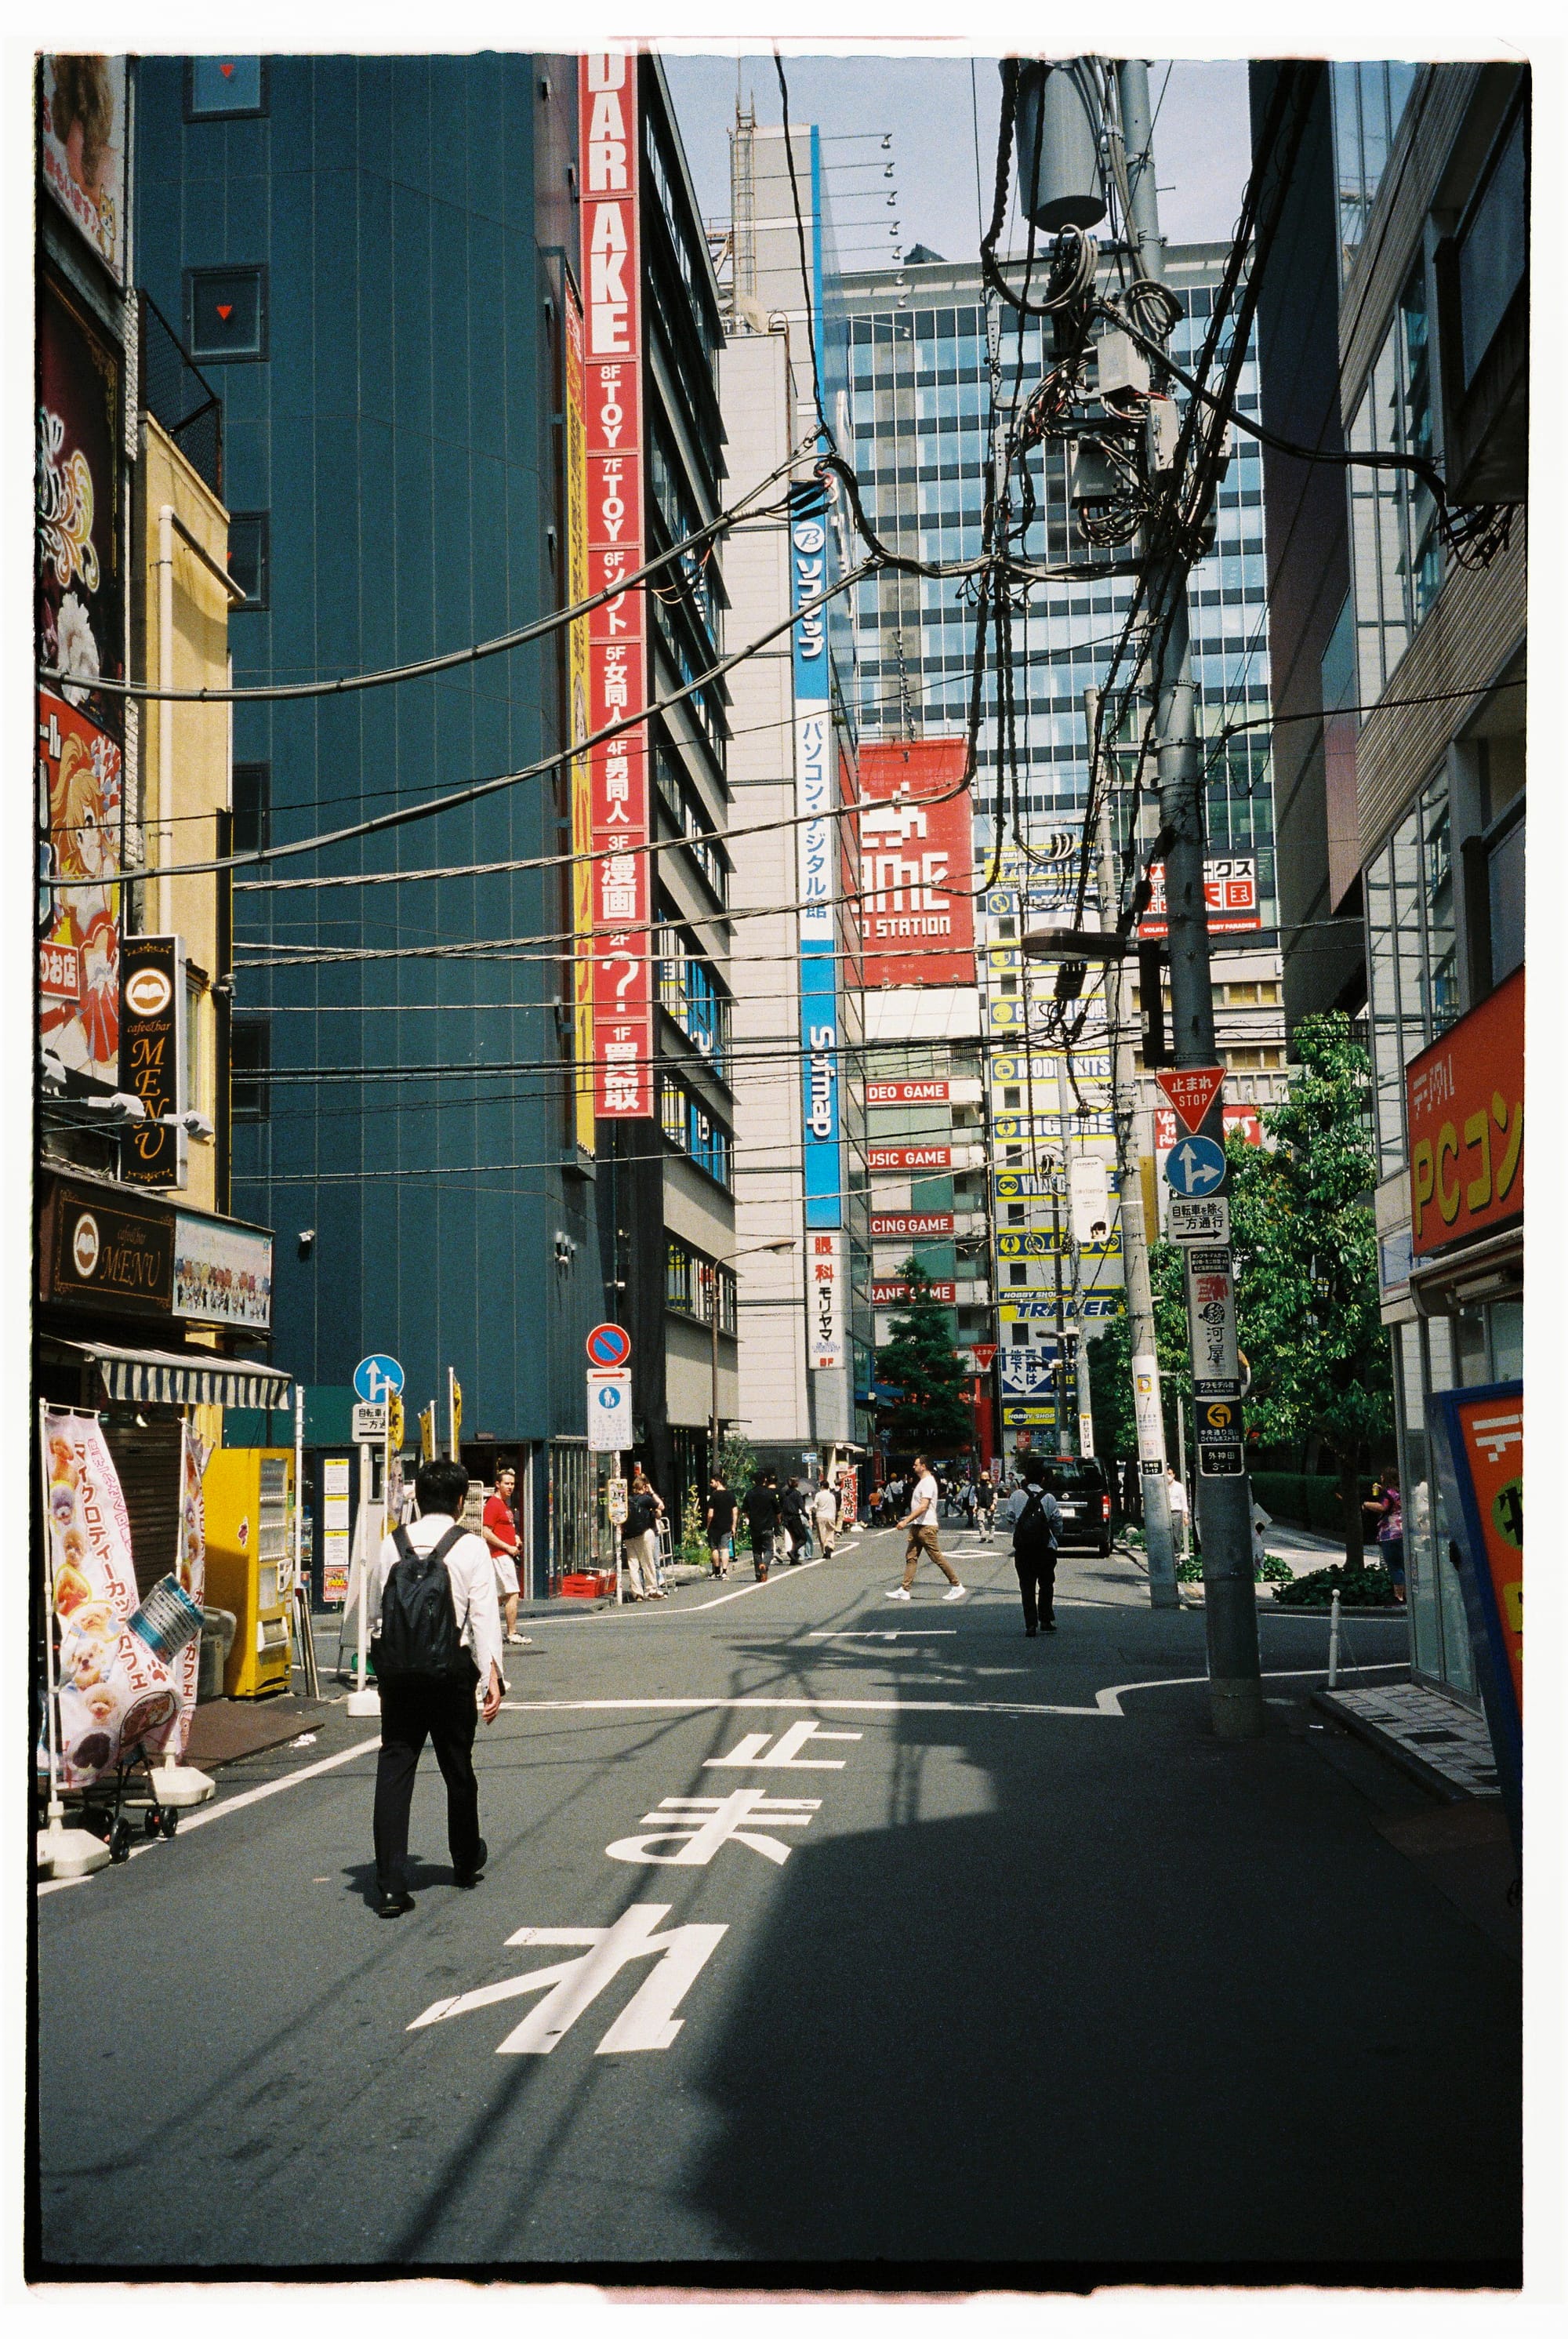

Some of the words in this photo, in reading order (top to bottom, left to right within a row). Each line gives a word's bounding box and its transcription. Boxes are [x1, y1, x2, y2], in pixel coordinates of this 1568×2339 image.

[601, 365, 620, 380] 8F
[601, 381, 623, 448] TOY
[603, 458, 622, 472] 7F
[603, 474, 624, 542] TOY
[604, 552, 624, 566] 6F
[606, 646, 626, 660] 5F
[604, 662, 627, 729] 女同人
[607, 740, 626, 755] 4F
[605, 756, 630, 824] 男同人
[608, 835, 629, 850] 3F
[601, 853, 637, 920] 漫画
[876, 917, 951, 938] STATION
[609, 932, 629, 946] 2F
[613, 1026, 631, 1041] 1F
[604, 1042, 640, 1111] 買取
[1171, 1075, 1213, 1093] 止まれ
[903, 1084, 945, 1098] GAME
[1179, 1094, 1208, 1107] STOP
[906, 1150, 946, 1164] GAME
[1172, 1203, 1223, 1217] 自転車を除く
[870, 1219, 906, 1232] CING
[908, 1218, 949, 1232] GAME
[1173, 1216, 1224, 1229] 一方通行
[100, 1245, 162, 1287] MENU
[815, 1236, 834, 1284] 眼科
[359, 1408, 386, 1418] 自転車
[405, 1721, 863, 2054] 止まれ
